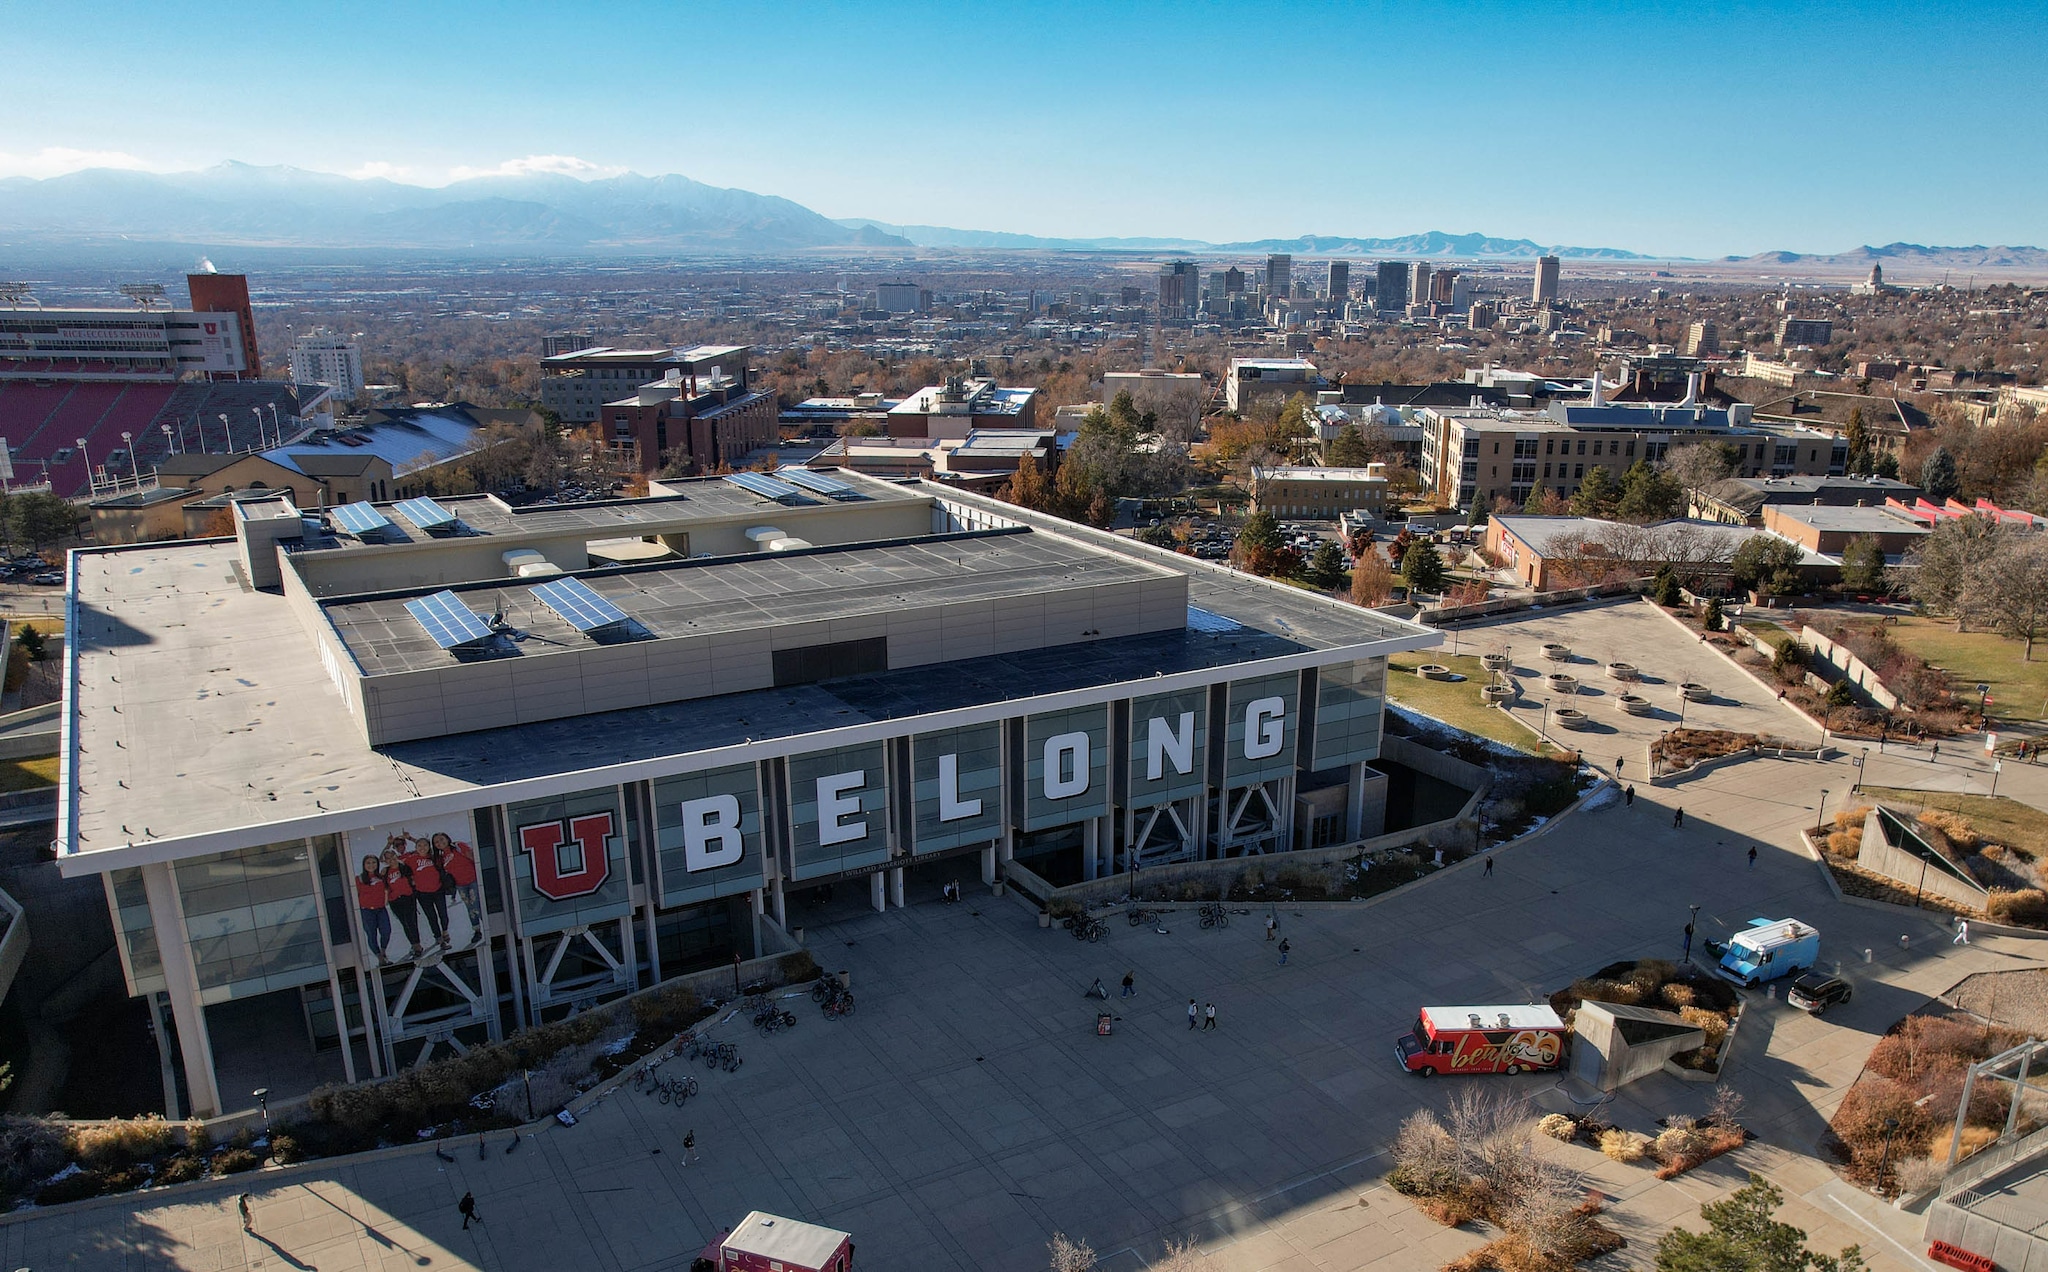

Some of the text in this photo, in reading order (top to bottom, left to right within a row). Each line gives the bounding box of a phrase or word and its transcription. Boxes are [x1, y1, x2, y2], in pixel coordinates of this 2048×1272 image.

[120, 330, 161, 338] STADIUM
[517, 696, 1286, 902] U BELONG
[845, 865, 876, 877] WILLARD
[878, 858, 913, 869] MARRIOTT
[914, 852, 942, 862] LIBRARY
[1450, 1033, 1522, 1072] bento
